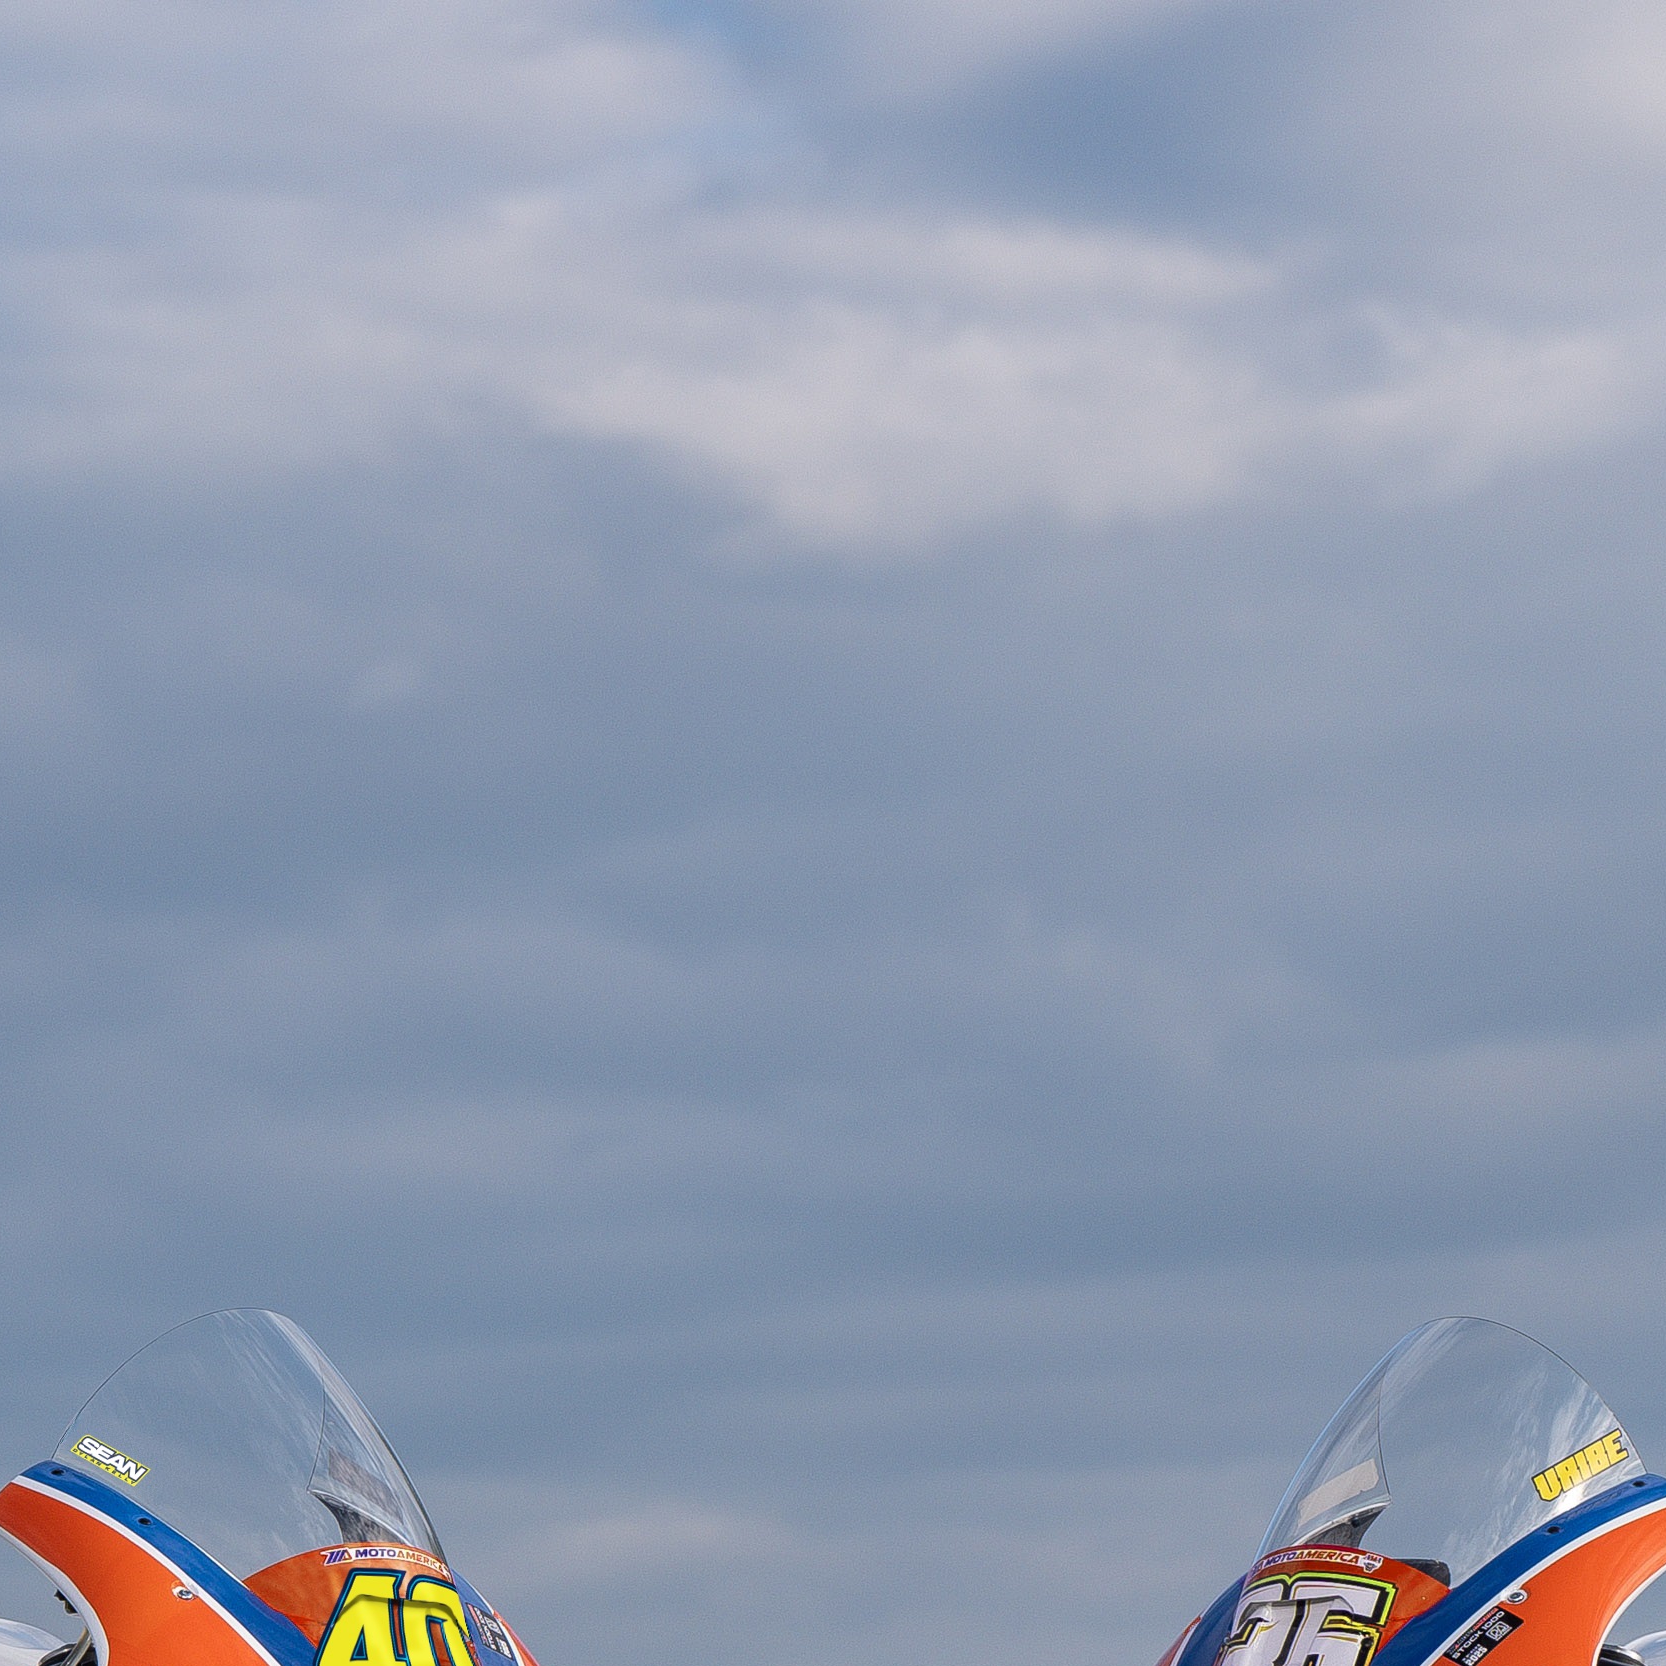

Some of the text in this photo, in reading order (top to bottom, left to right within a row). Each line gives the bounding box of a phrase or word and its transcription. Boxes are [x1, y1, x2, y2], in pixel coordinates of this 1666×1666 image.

[73, 1448, 136, 1485] DYLAN KELLY
[77, 1437, 148, 1482] SEAN
[1531, 1428, 1629, 1502] URIBE
[1264, 1551, 1360, 1567] MOTOAMERICA
[1452, 1631, 1484, 1659] STOCK
[1482, 1611, 1505, 1631] 1000
[1464, 1646, 1488, 1666] 2025
